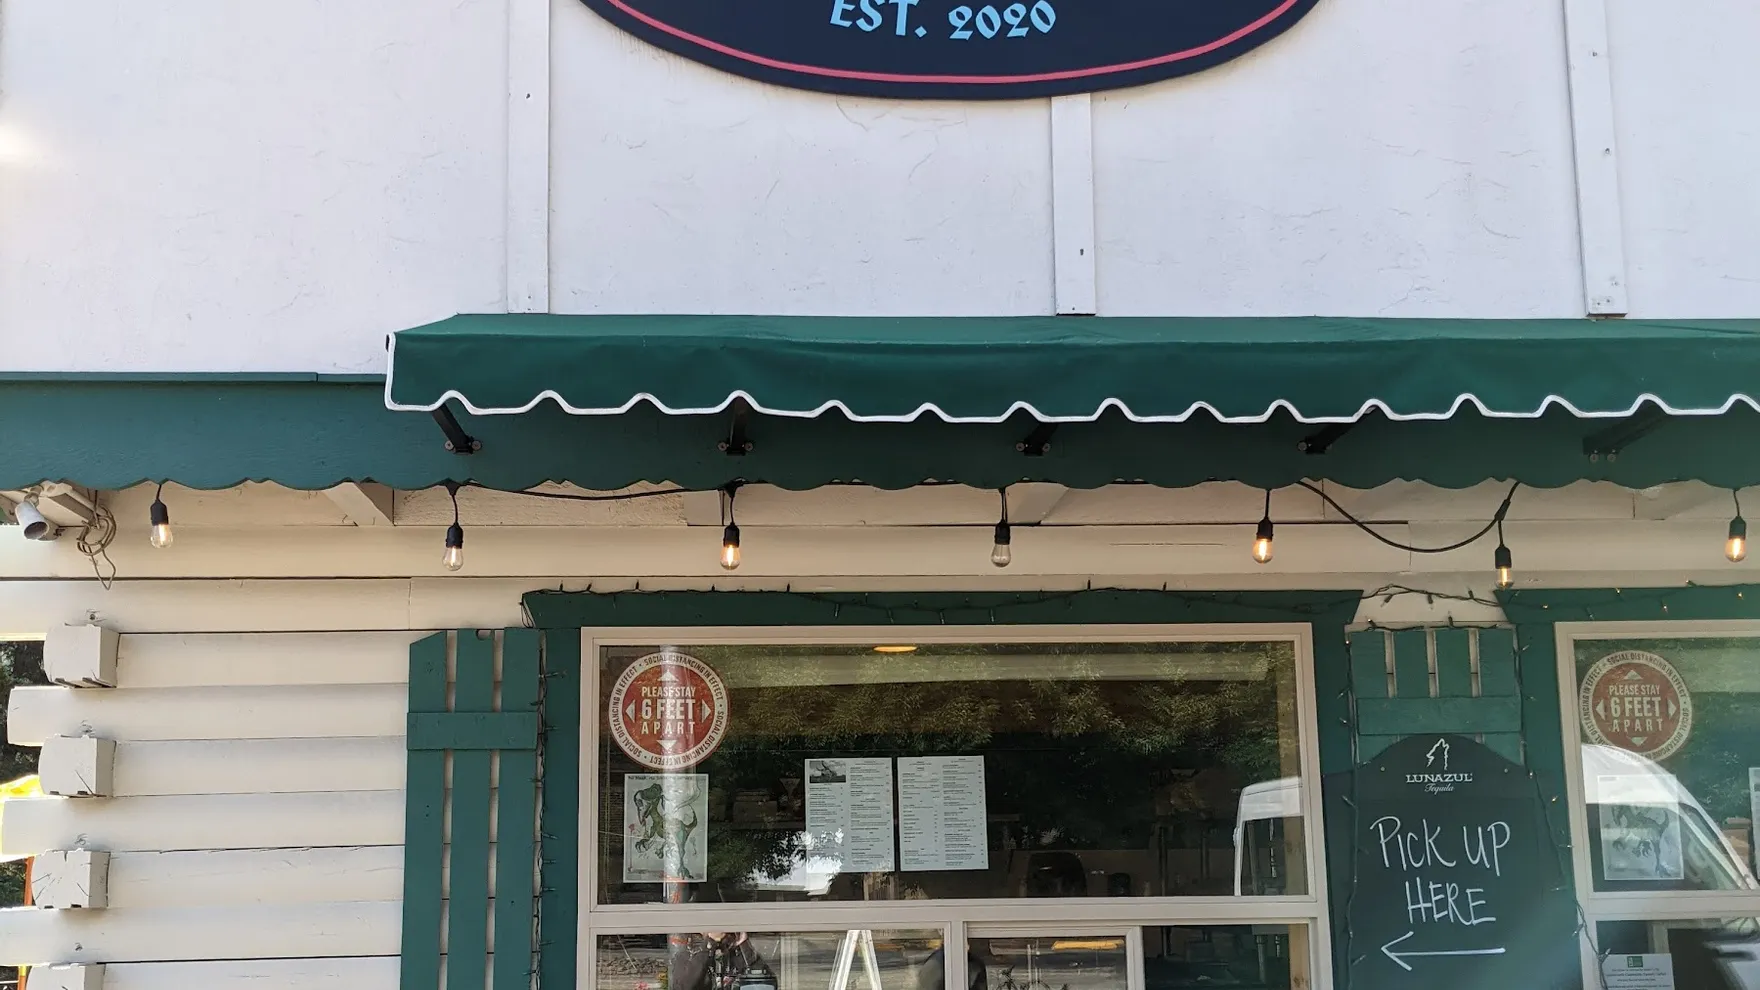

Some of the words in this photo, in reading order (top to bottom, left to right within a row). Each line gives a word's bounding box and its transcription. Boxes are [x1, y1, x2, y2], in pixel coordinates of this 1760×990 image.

[830, 0, 927, 38] EST.
[948, 0, 1056, 40] 2020
[620, 666, 638, 687] EFFECT
[1586, 666, 1602, 686] EFFECT
[1607, 653, 1629, 665] SOCIAL
[1671, 674, 1686, 698] EFFECT
[642, 686, 673, 697] PLEASE
[675, 686, 696, 697] STAY
[708, 676, 724, 700] EFFECT
[1609, 684, 1640, 695] PLEASE
[1640, 684, 1660, 695] STAY
[612, 697, 625, 738] DISTANCING
[642, 698, 652, 720] 6
[656, 698, 696, 720] FEET
[1610, 697, 1620, 718] 6
[1624, 697, 1661, 717] FEET
[641, 722, 696, 734] APART
[713, 710, 724, 736] SOCIAL
[1612, 718, 1663, 732] APART
[622, 737, 642, 757] SOCIAL
[1406, 774, 1472, 782] LUNAZUL
[1424, 783, 1454, 795] Tequila
[1463, 822, 1510, 876] UP
[1405, 877, 1496, 926] HERE
